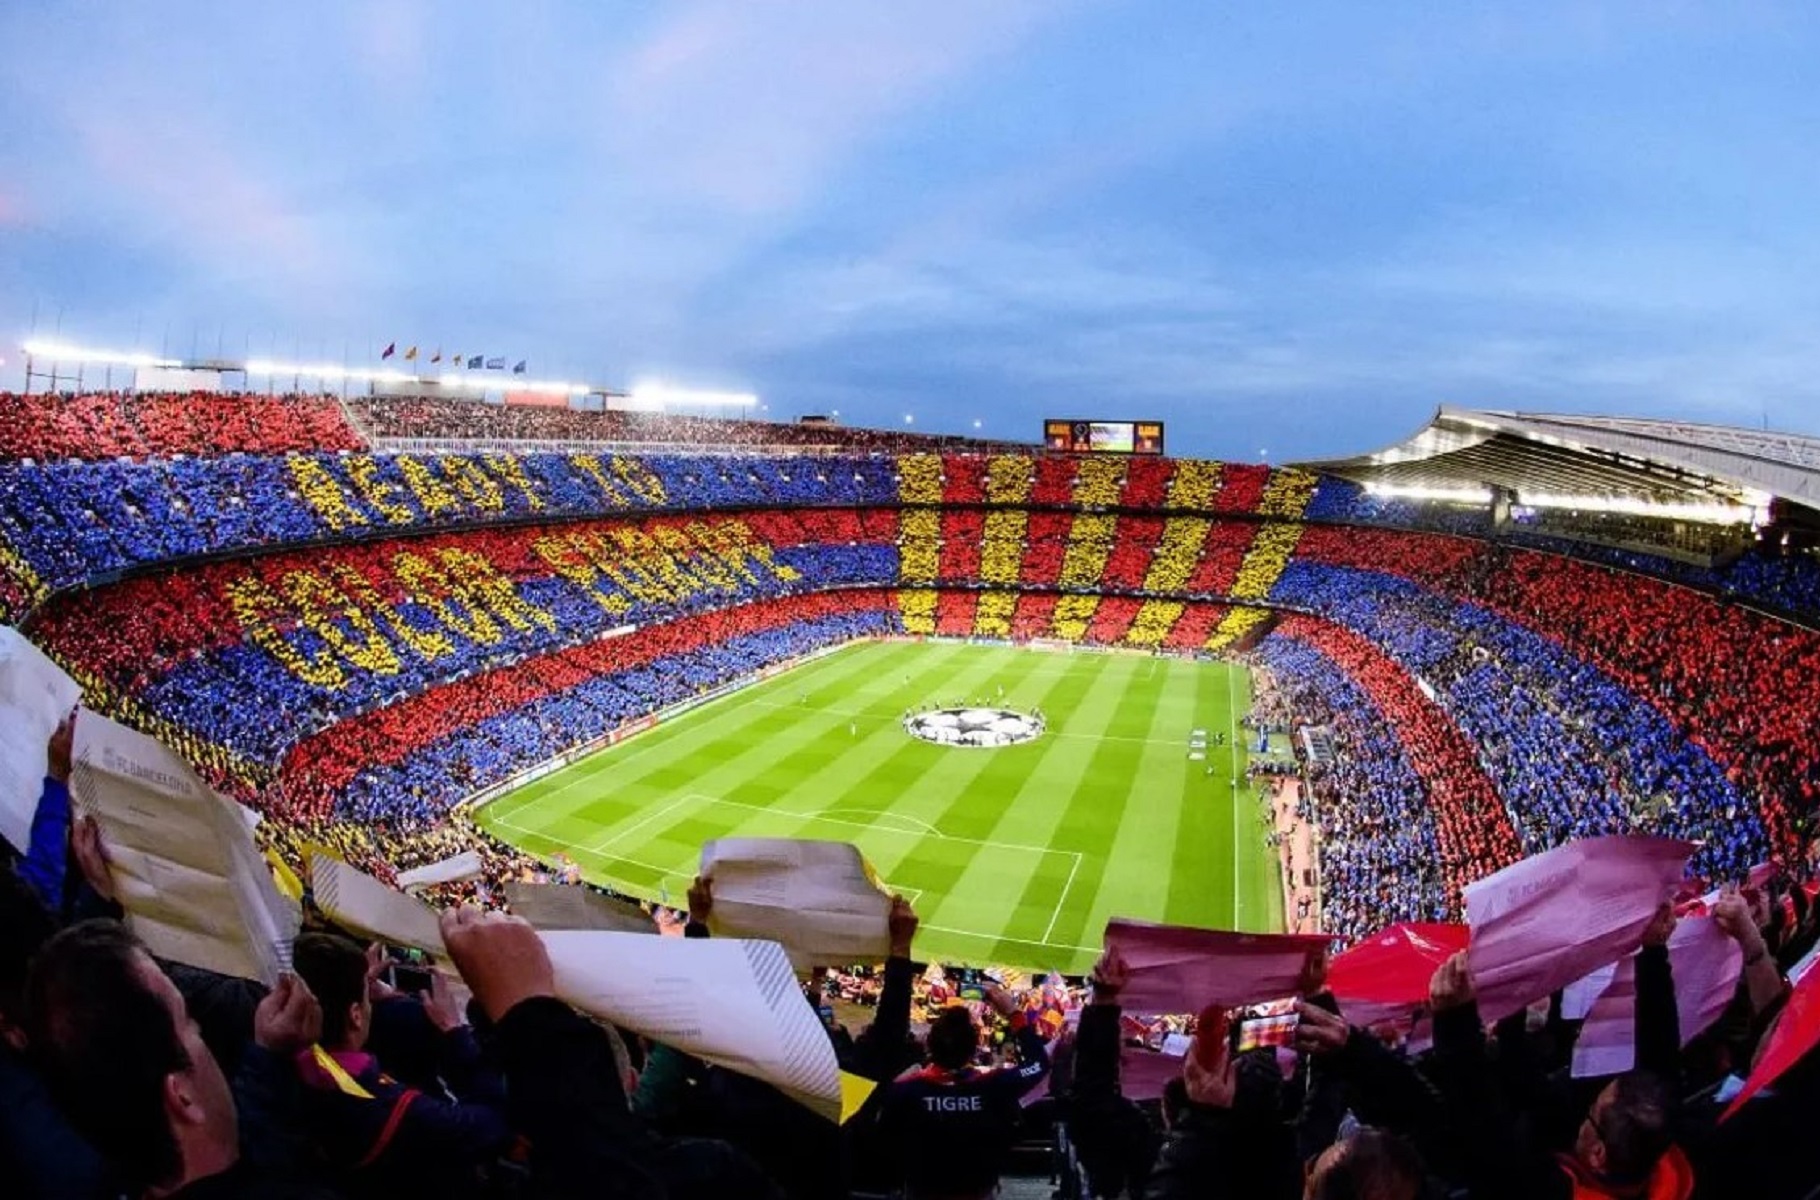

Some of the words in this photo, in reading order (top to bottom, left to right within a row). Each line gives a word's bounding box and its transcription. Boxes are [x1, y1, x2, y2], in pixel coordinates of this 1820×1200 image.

[286, 453, 544, 530] READY
[570, 454, 667, 507] TO
[226, 547, 557, 690] COLOR
[923, 1096, 983, 1112] TIGRE
